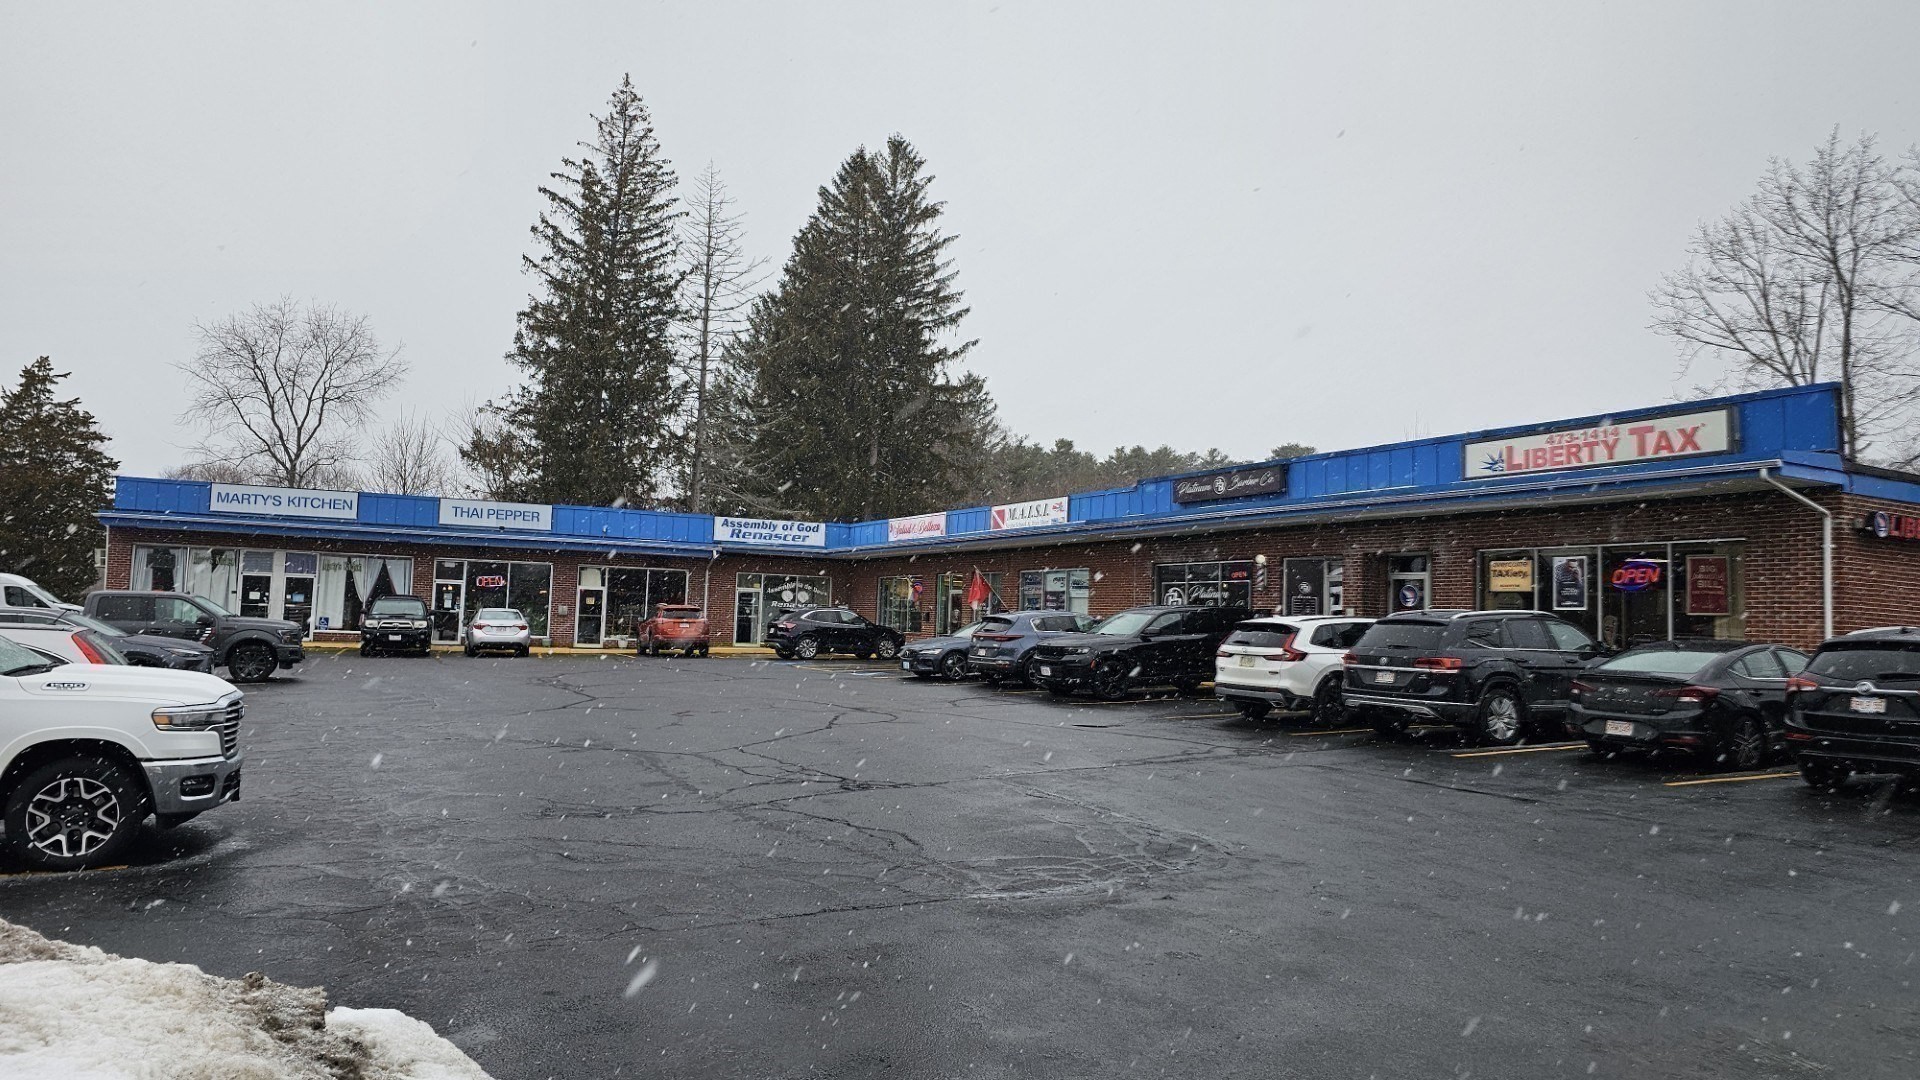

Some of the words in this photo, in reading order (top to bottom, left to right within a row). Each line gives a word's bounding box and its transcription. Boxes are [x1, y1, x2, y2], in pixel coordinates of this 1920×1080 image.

[1545, 426, 1620, 445] 473-1414
[1505, 437, 1620, 471] LIBERTY
[1628, 425, 1702, 457] TAX
[1177, 481, 1212, 496] Platinum
[1228, 474, 1259, 491] Barber
[216, 491, 282, 507] MARTY'S
[287, 496, 353, 511] KITCHEN
[452, 506, 483, 518] THAI
[487, 508, 540, 522] PEPPER
[721, 518, 778, 532] Assembly
[782, 522, 793, 531] of
[797, 523, 819, 533] God
[730, 528, 810, 542] Renascer
[478, 576, 502, 586] OPEN
[1231, 571, 1247, 579] OPEN
[1611, 568, 1660, 584] OPEN
